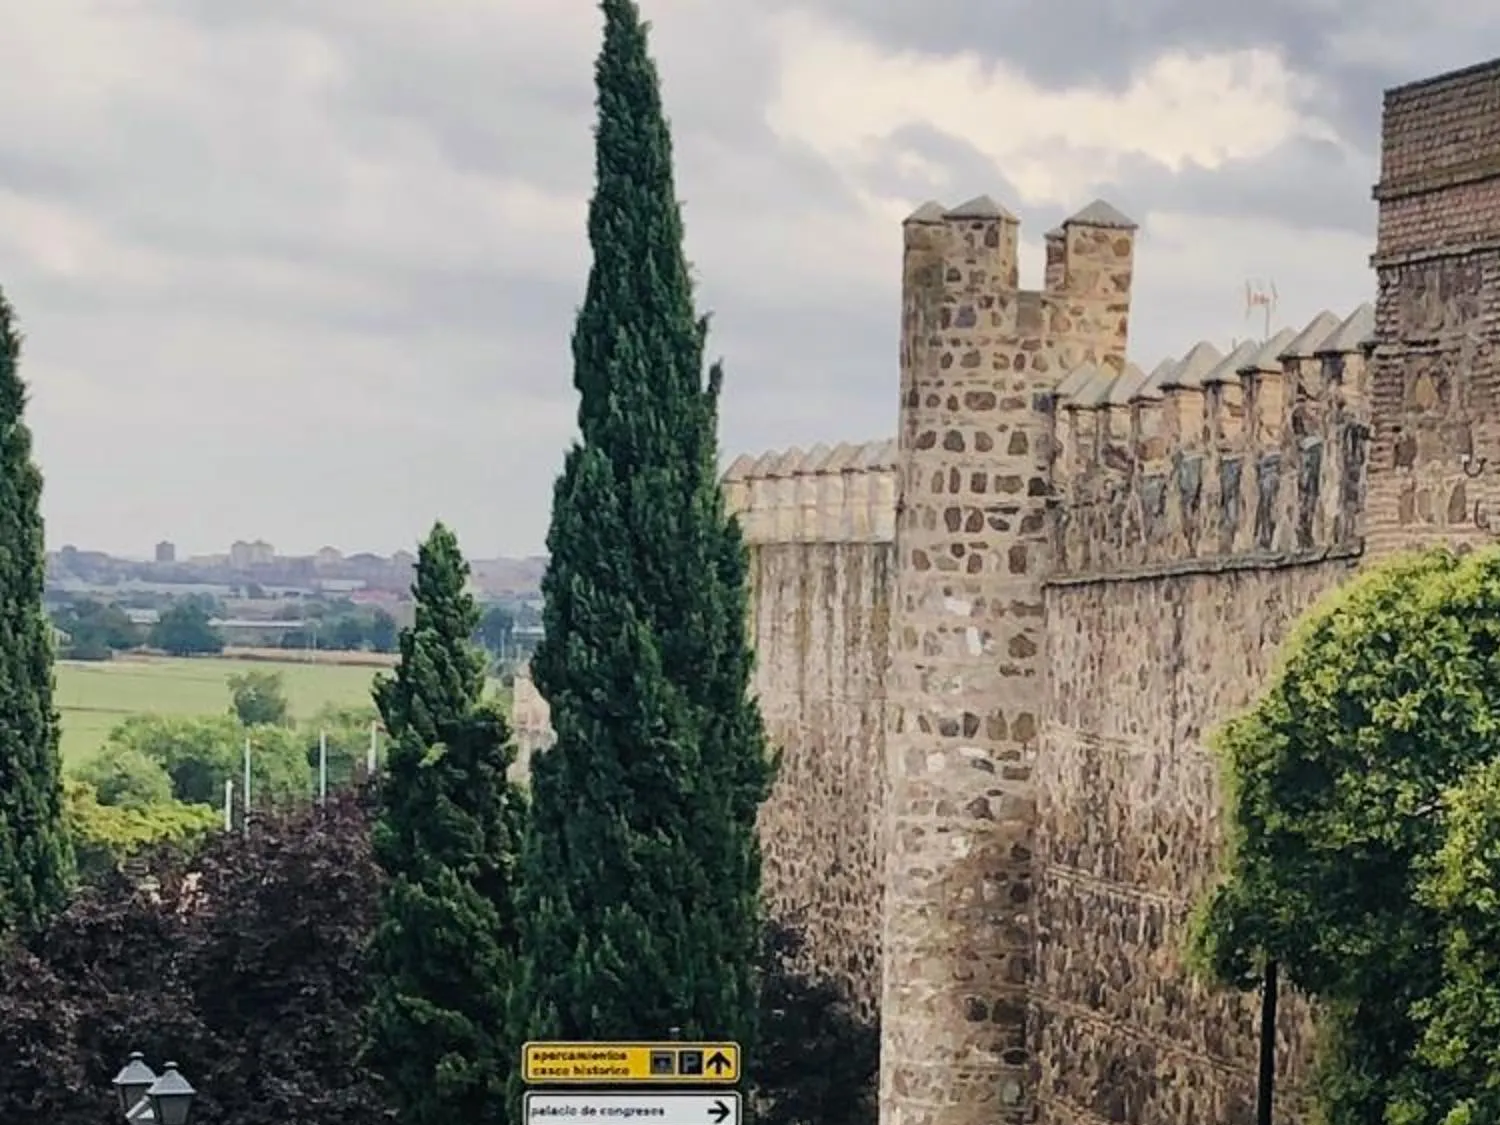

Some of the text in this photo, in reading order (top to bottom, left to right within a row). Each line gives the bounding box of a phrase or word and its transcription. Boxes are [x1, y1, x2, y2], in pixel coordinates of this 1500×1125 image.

[683, 1053, 699, 1073] P
[533, 1066, 570, 1076] casco
[532, 1105, 665, 1118] palacio de congresos
